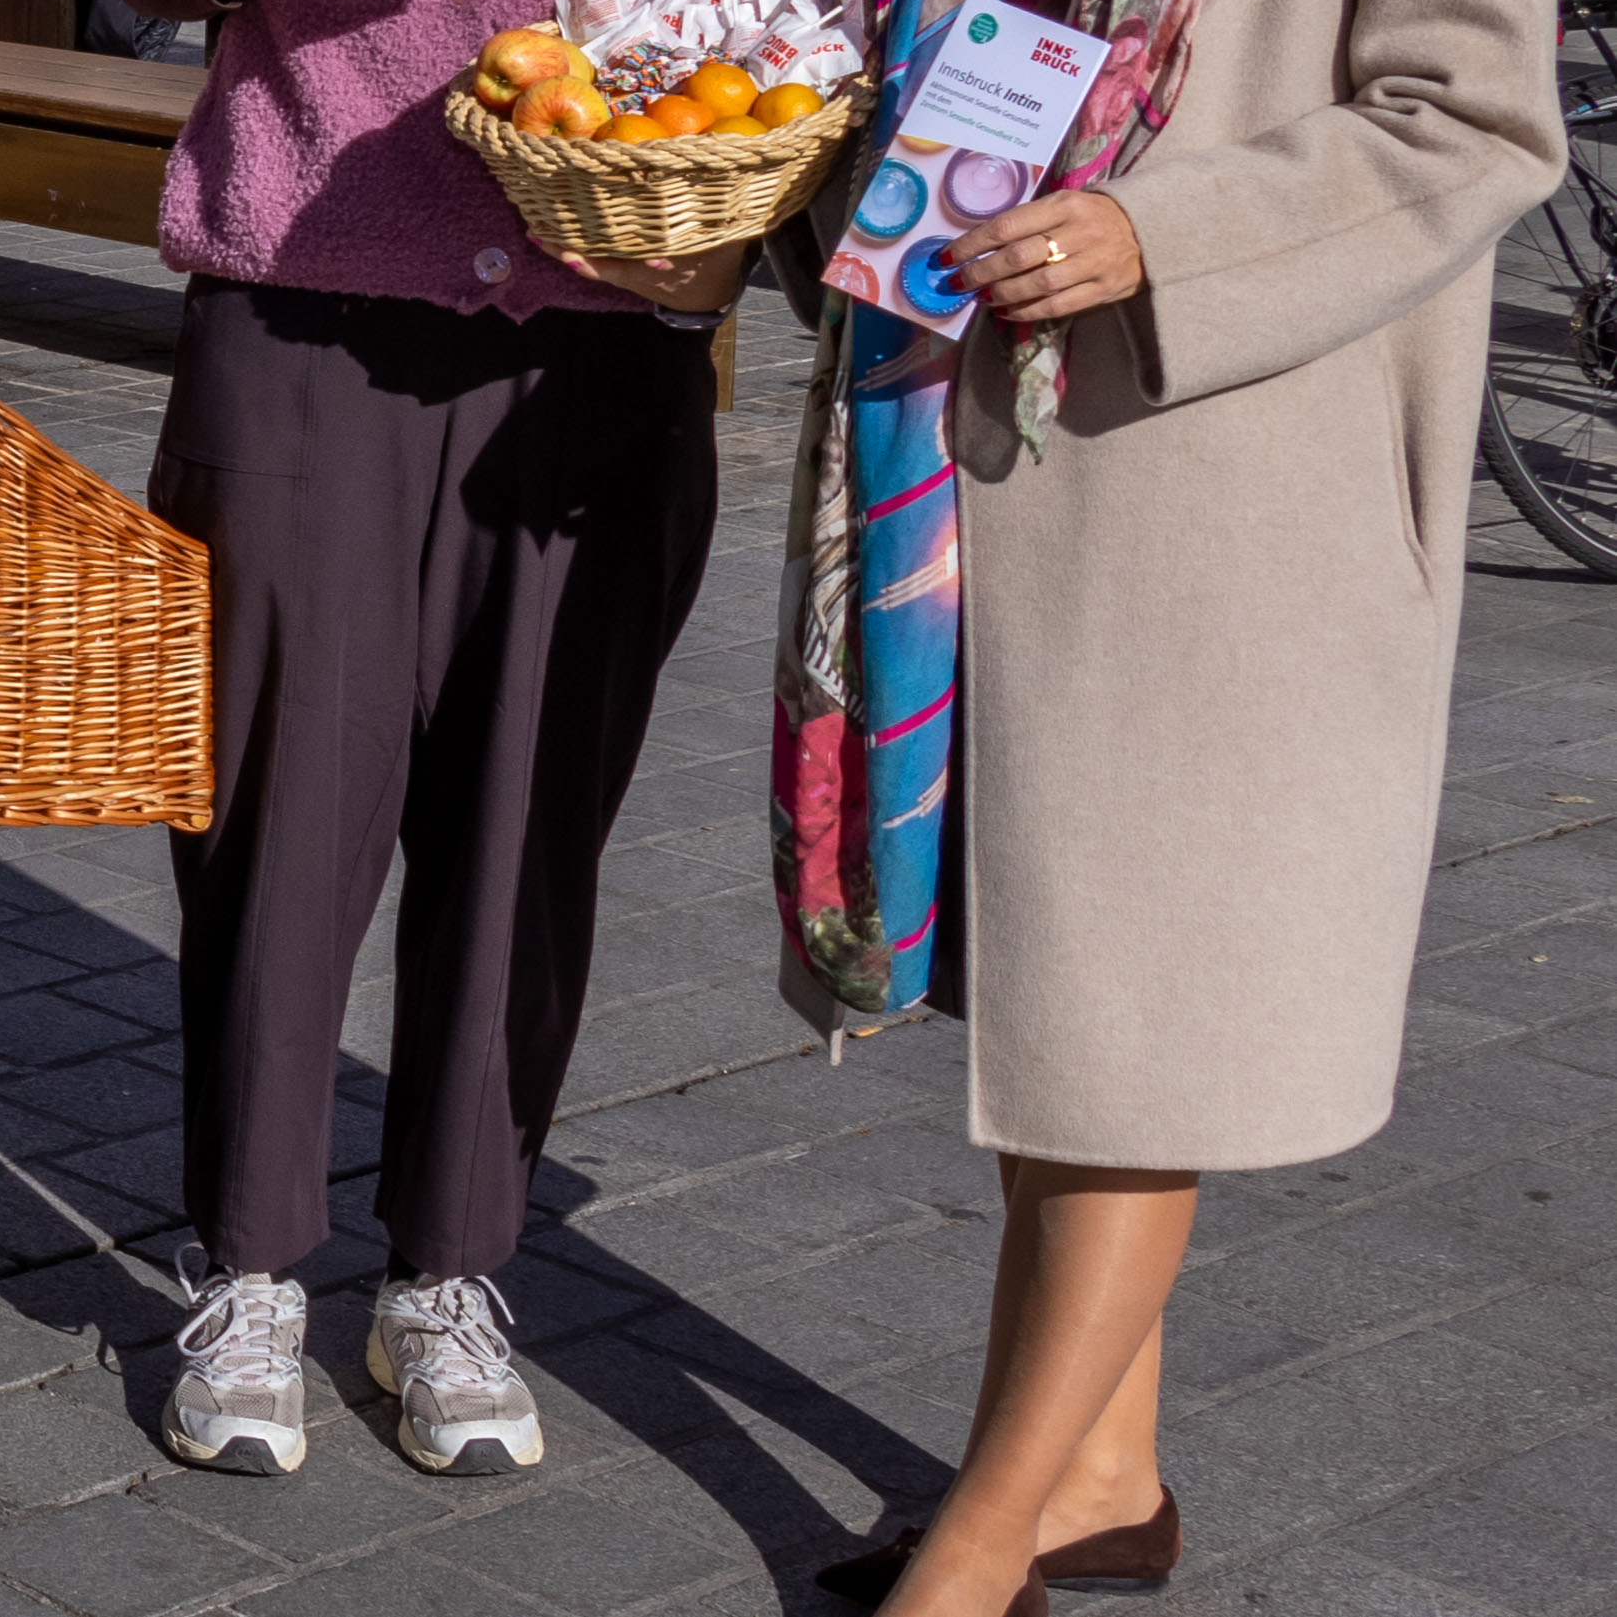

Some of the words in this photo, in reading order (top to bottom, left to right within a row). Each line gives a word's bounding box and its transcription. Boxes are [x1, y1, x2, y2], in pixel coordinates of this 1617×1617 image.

[1031, 49, 1081, 77] BRUCK
[937, 61, 1005, 96] Innsbruck
[1003, 88, 1043, 113] Intim
